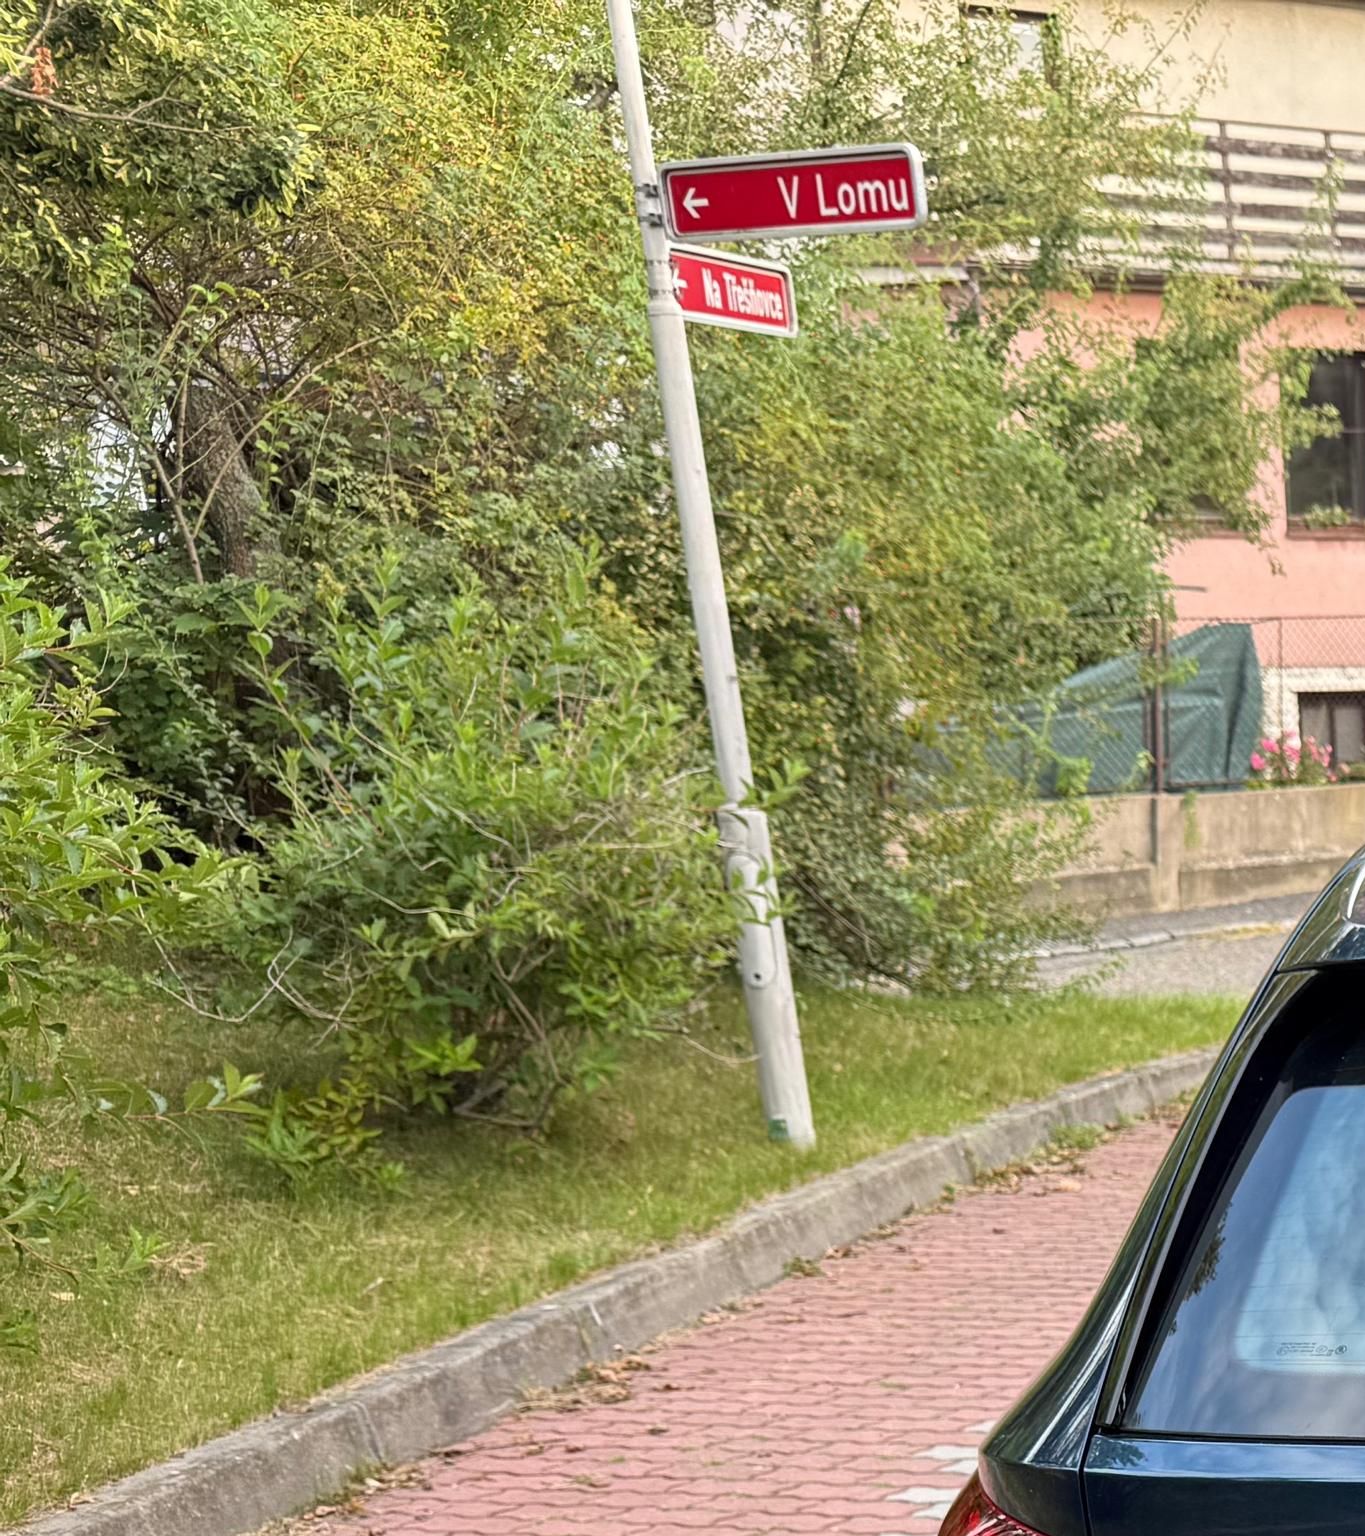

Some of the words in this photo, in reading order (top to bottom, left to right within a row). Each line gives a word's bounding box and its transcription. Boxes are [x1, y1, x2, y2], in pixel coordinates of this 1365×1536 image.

[777, 175, 799, 220] V
[814, 173, 910, 217] Lomu
[701, 267, 723, 310] Na
